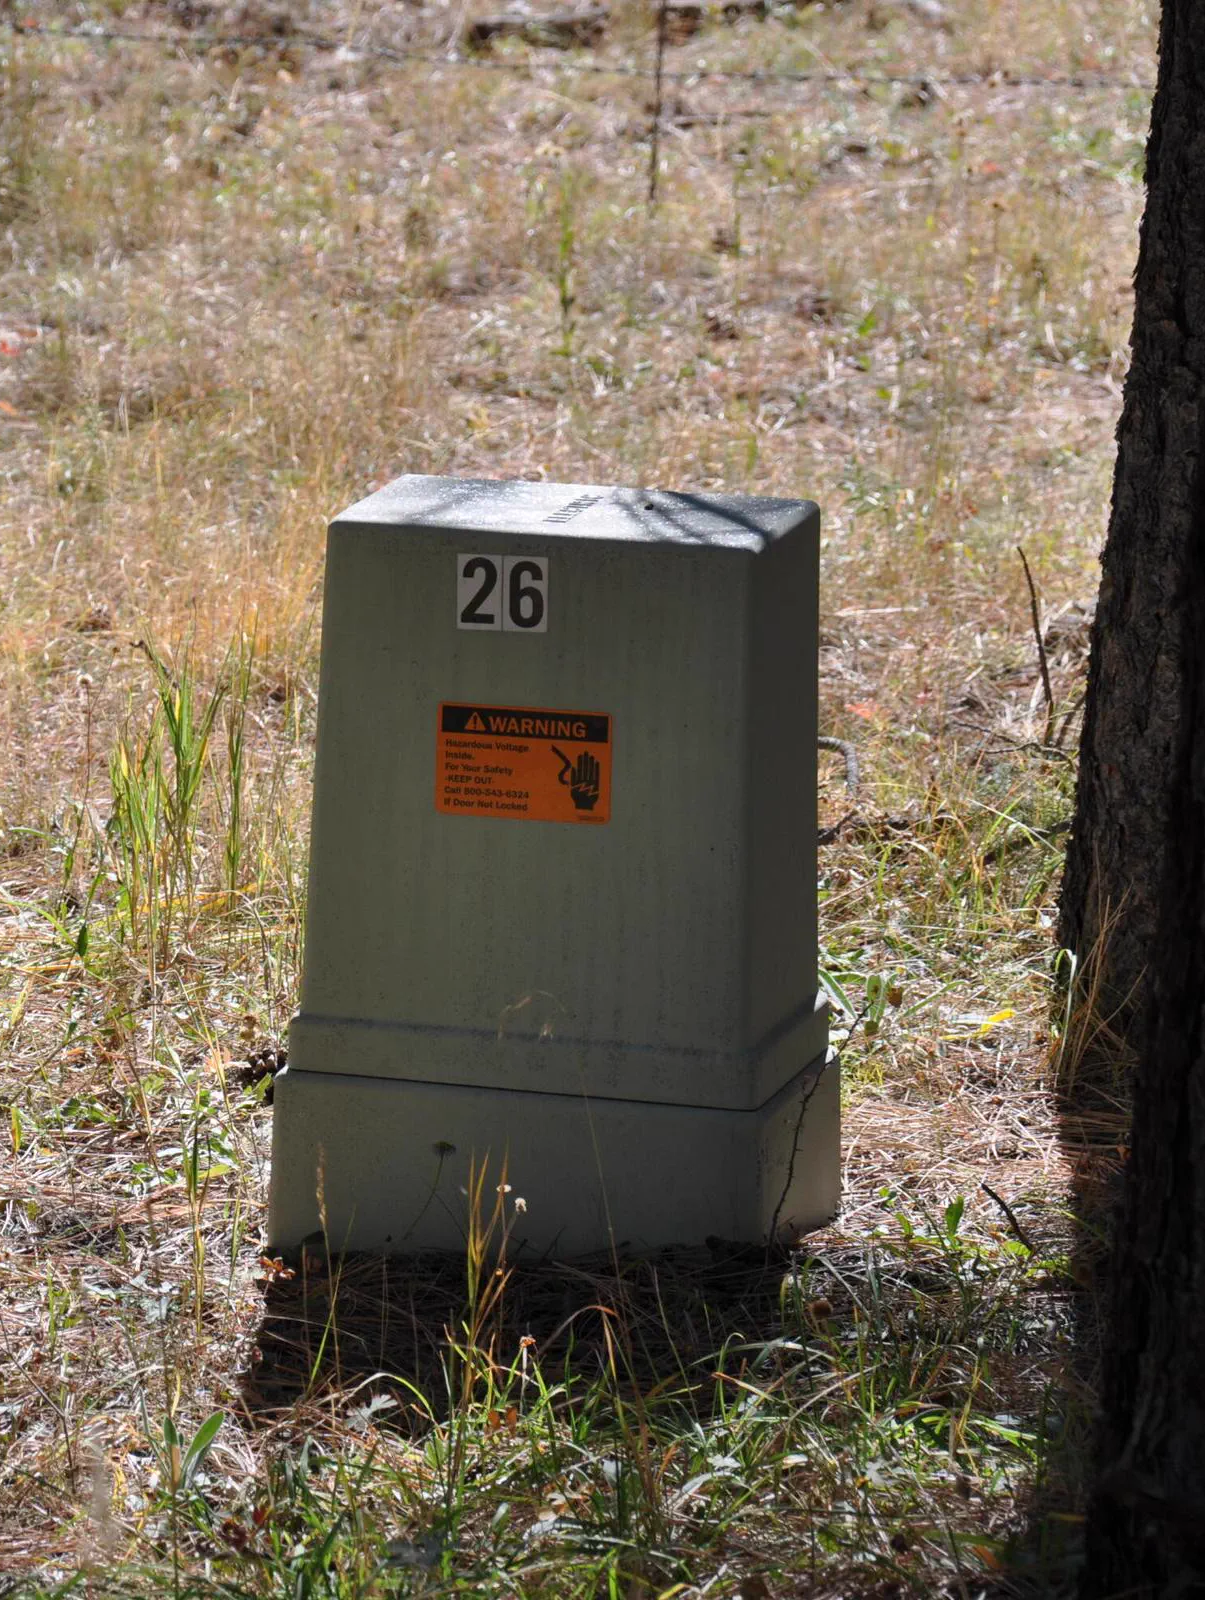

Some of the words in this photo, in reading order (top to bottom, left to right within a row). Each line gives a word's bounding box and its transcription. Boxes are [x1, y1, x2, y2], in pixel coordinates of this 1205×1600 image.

[461, 557, 544, 628] 26
[488, 716, 588, 739] WARNING
[445, 739, 493, 750] Hazardous
[495, 742, 530, 754] Voltage
[445, 751, 476, 760] Inside.
[444, 762, 458, 771] For
[460, 763, 481, 773] Your
[483, 765, 514, 776] Safety
[444, 786, 461, 794] Call
[443, 797, 451, 806] If
[453, 798, 475, 807] Door
[477, 799, 493, 809] Not
[495, 801, 528, 811] Locked
